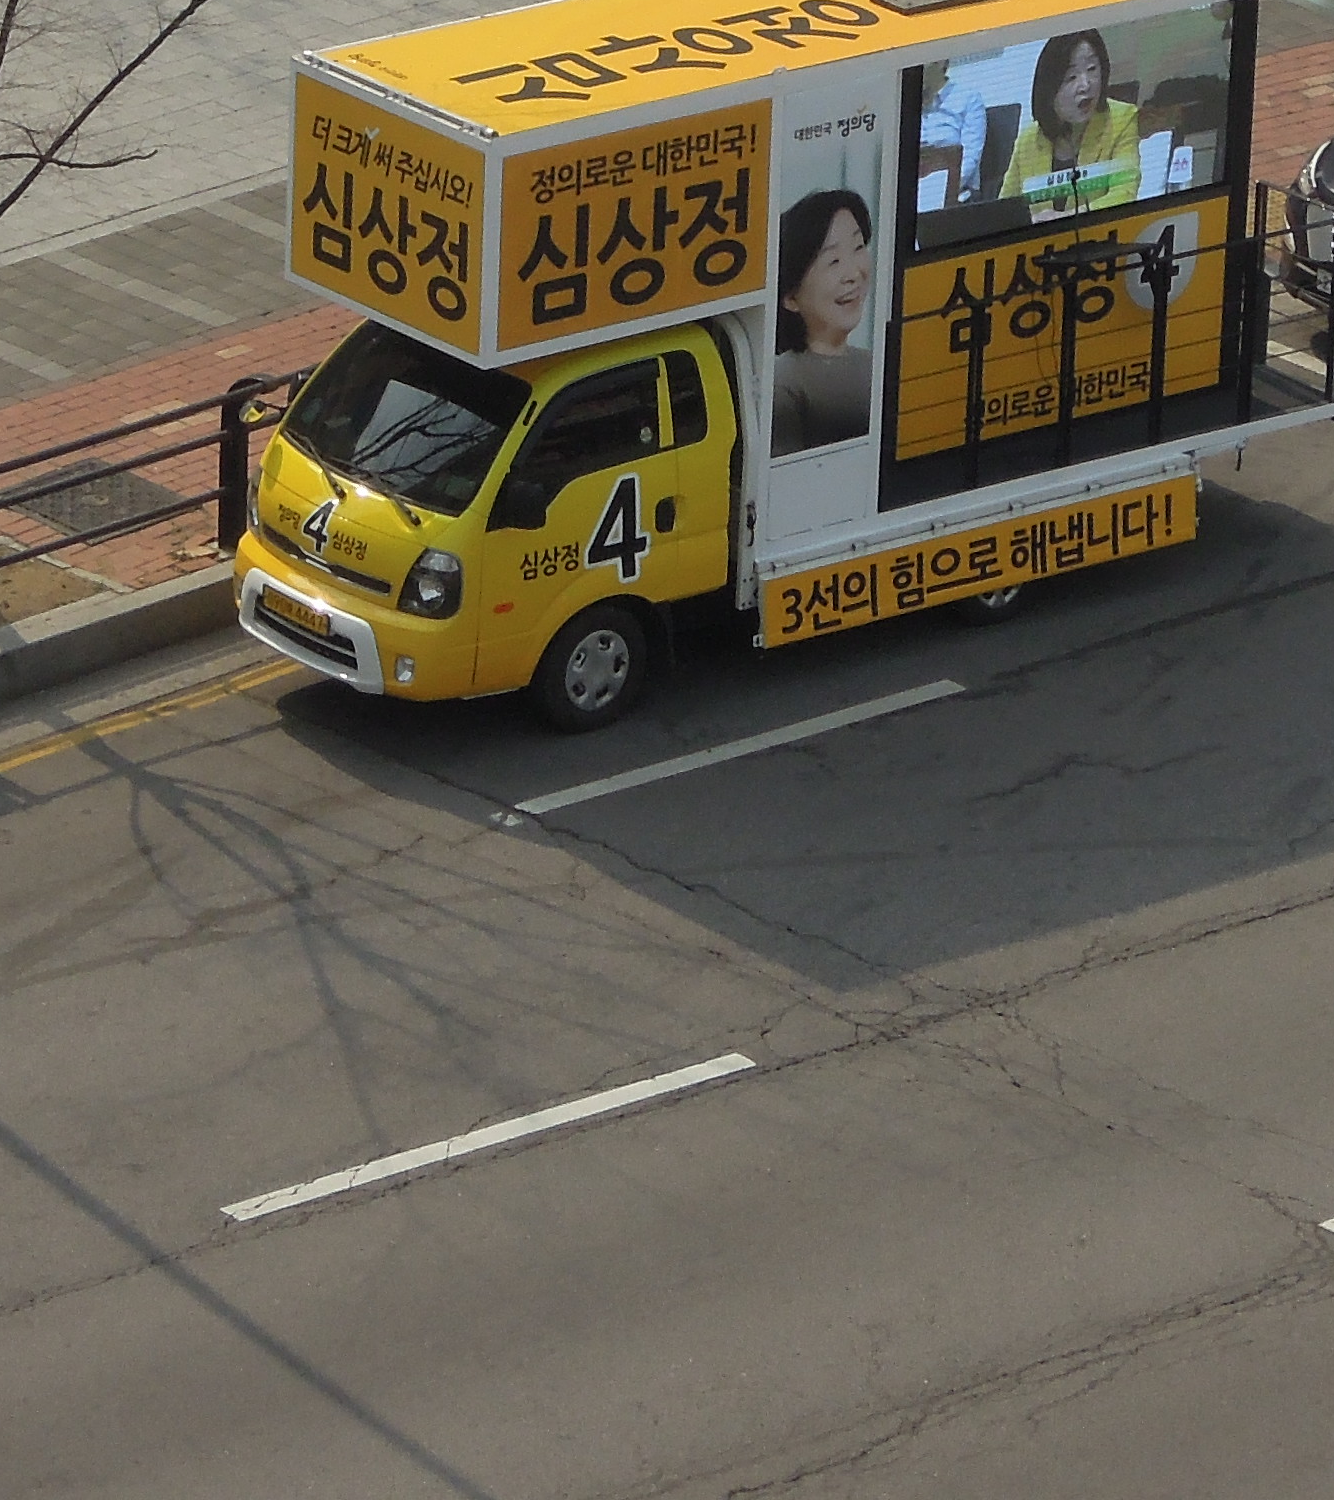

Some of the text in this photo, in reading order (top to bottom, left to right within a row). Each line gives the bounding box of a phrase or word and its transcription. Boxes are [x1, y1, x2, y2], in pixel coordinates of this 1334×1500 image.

[312, 114, 474, 210] 더 크게 써 주십시오!
[529, 123, 759, 205] 정의로운 대한민국!
[794, 112, 877, 141] 대한민국 정의당
[302, 162, 470, 322] 심상정
[517, 167, 751, 326] 심상정
[978, 384, 1057, 427] 의로운
[303, 500, 337, 553] 4
[332, 529, 368, 561] 심상정
[519, 476, 648, 581] 심상정 4
[781, 492, 1174, 635] 3선의 힘으로 해냅니다!
